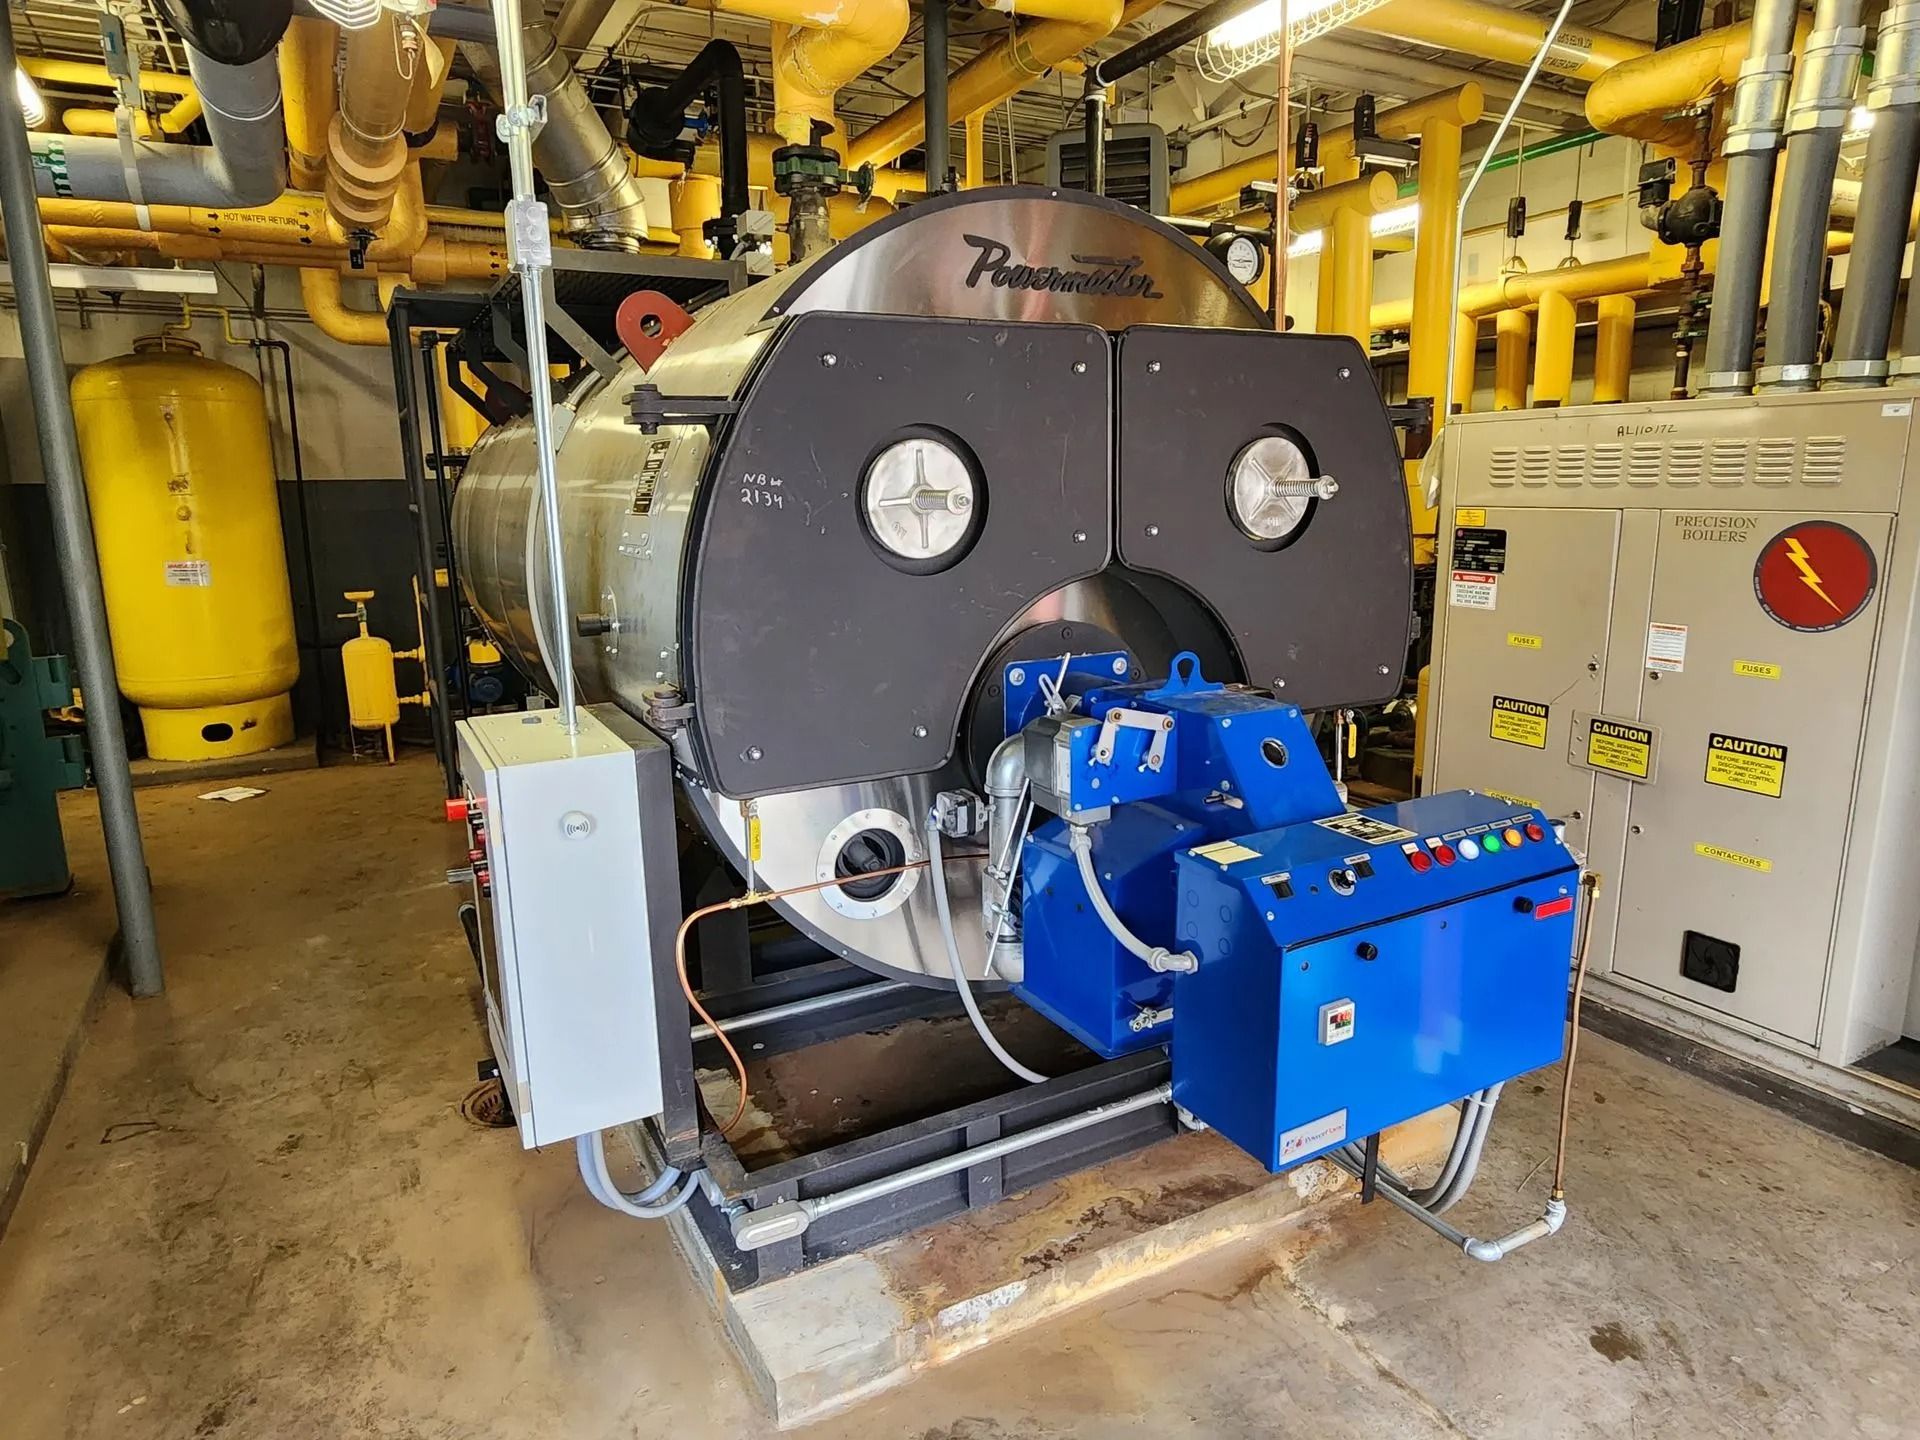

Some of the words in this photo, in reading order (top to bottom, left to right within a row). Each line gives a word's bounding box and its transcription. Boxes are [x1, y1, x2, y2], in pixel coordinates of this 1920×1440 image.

[223, 212, 238, 221] HOT
[240, 213, 266, 223] WATER
[268, 216, 299, 226] RETURN
[962, 233, 1164, 299] Powermaster
[741, 488, 783, 509] 2134
[1675, 515, 1759, 529] PRECISION
[1682, 529, 1748, 543] BOILERS
[1513, 636, 1535, 645] FUSES
[1741, 664, 1772, 675] FUSES
[1495, 698, 1546, 716] CAUTION
[1499, 719, 1528, 729] DISCONNECT
[1517, 717, 1541, 726] SERVICING
[1507, 731, 1529, 740] CIRCUITS
[1521, 729, 1542, 737] CONTROL
[1593, 721, 1649, 743] CAUTION
[1595, 738, 1615, 746] BEFORE
[1616, 743, 1643, 753] SERVICING
[1597, 744, 1629, 756] DISCONNECT
[1712, 736, 1783, 760] CAUTION
[1592, 748, 1609, 757] SUPPLY
[1621, 756, 1644, 766] CONTROL
[1605, 758, 1629, 767] CIRCUITS
[1715, 754, 1740, 763] BEFORE
[1742, 759, 1776, 771] SERVICING
[1711, 766, 1733, 775] SUPPLY
[1748, 773, 1777, 784] CONTROL
[1718, 761, 1757, 774] DISCONNECT
[1760, 769, 1771, 777] ALL
[1728, 776, 1758, 787] CIRCUITS
[1703, 846, 1761, 867] CONTACTORS
